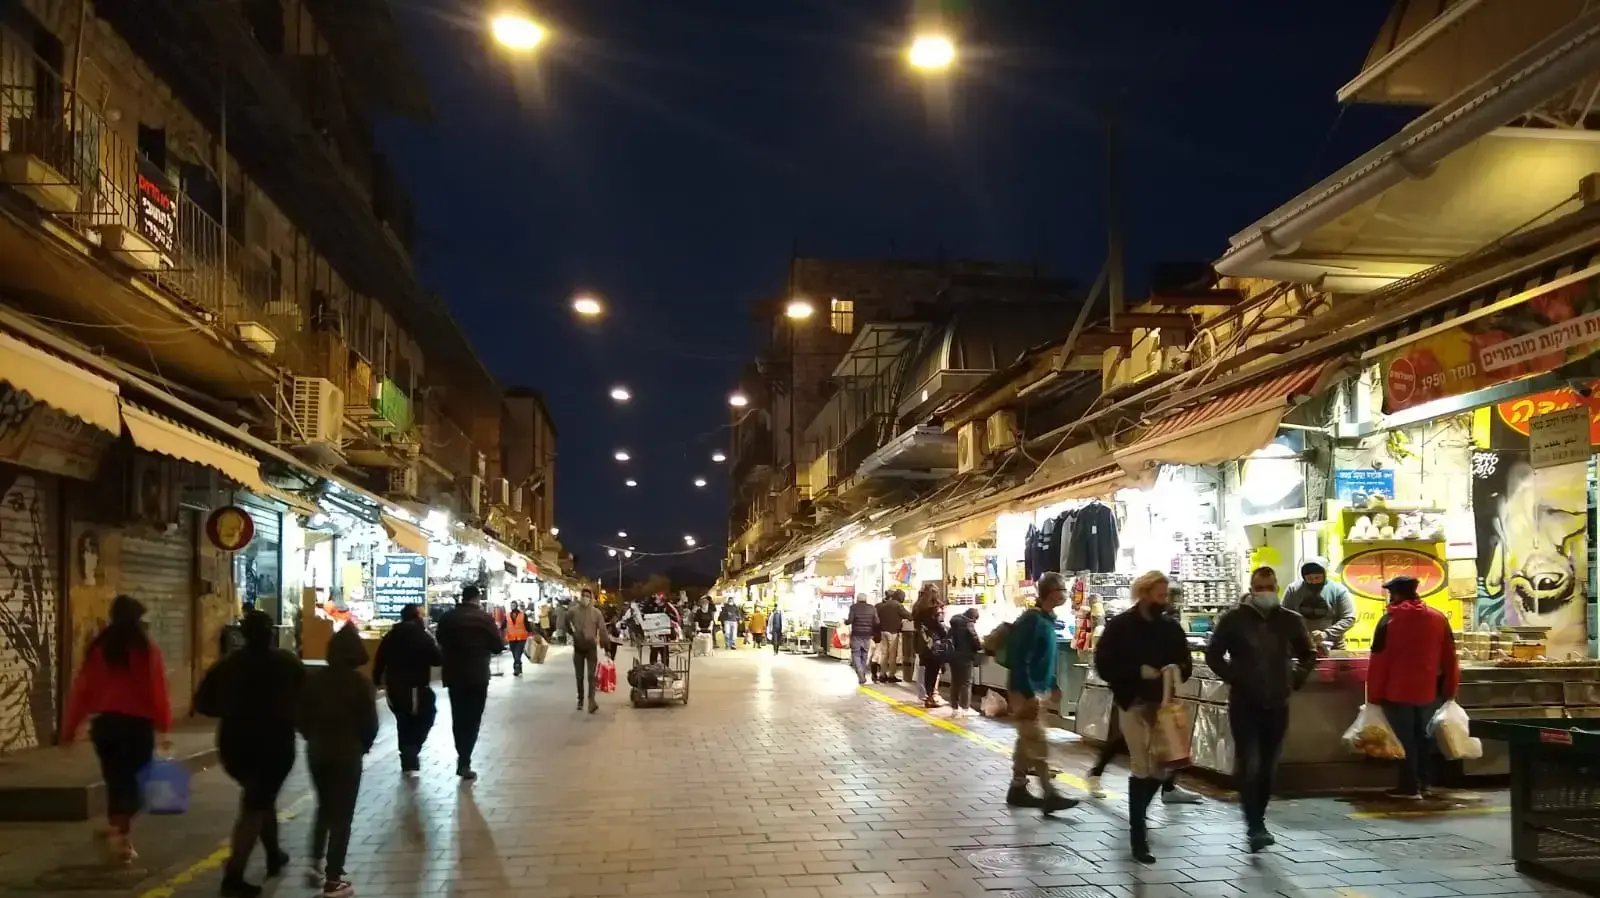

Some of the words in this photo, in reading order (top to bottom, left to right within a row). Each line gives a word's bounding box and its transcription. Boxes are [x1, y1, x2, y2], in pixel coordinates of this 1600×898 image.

[1538, 324, 1582, 349] וירקות
[1482, 341, 1537, 366] מובחרים
[1421, 371, 1446, 391] 1950
[1449, 363, 1477, 382] נוסד
